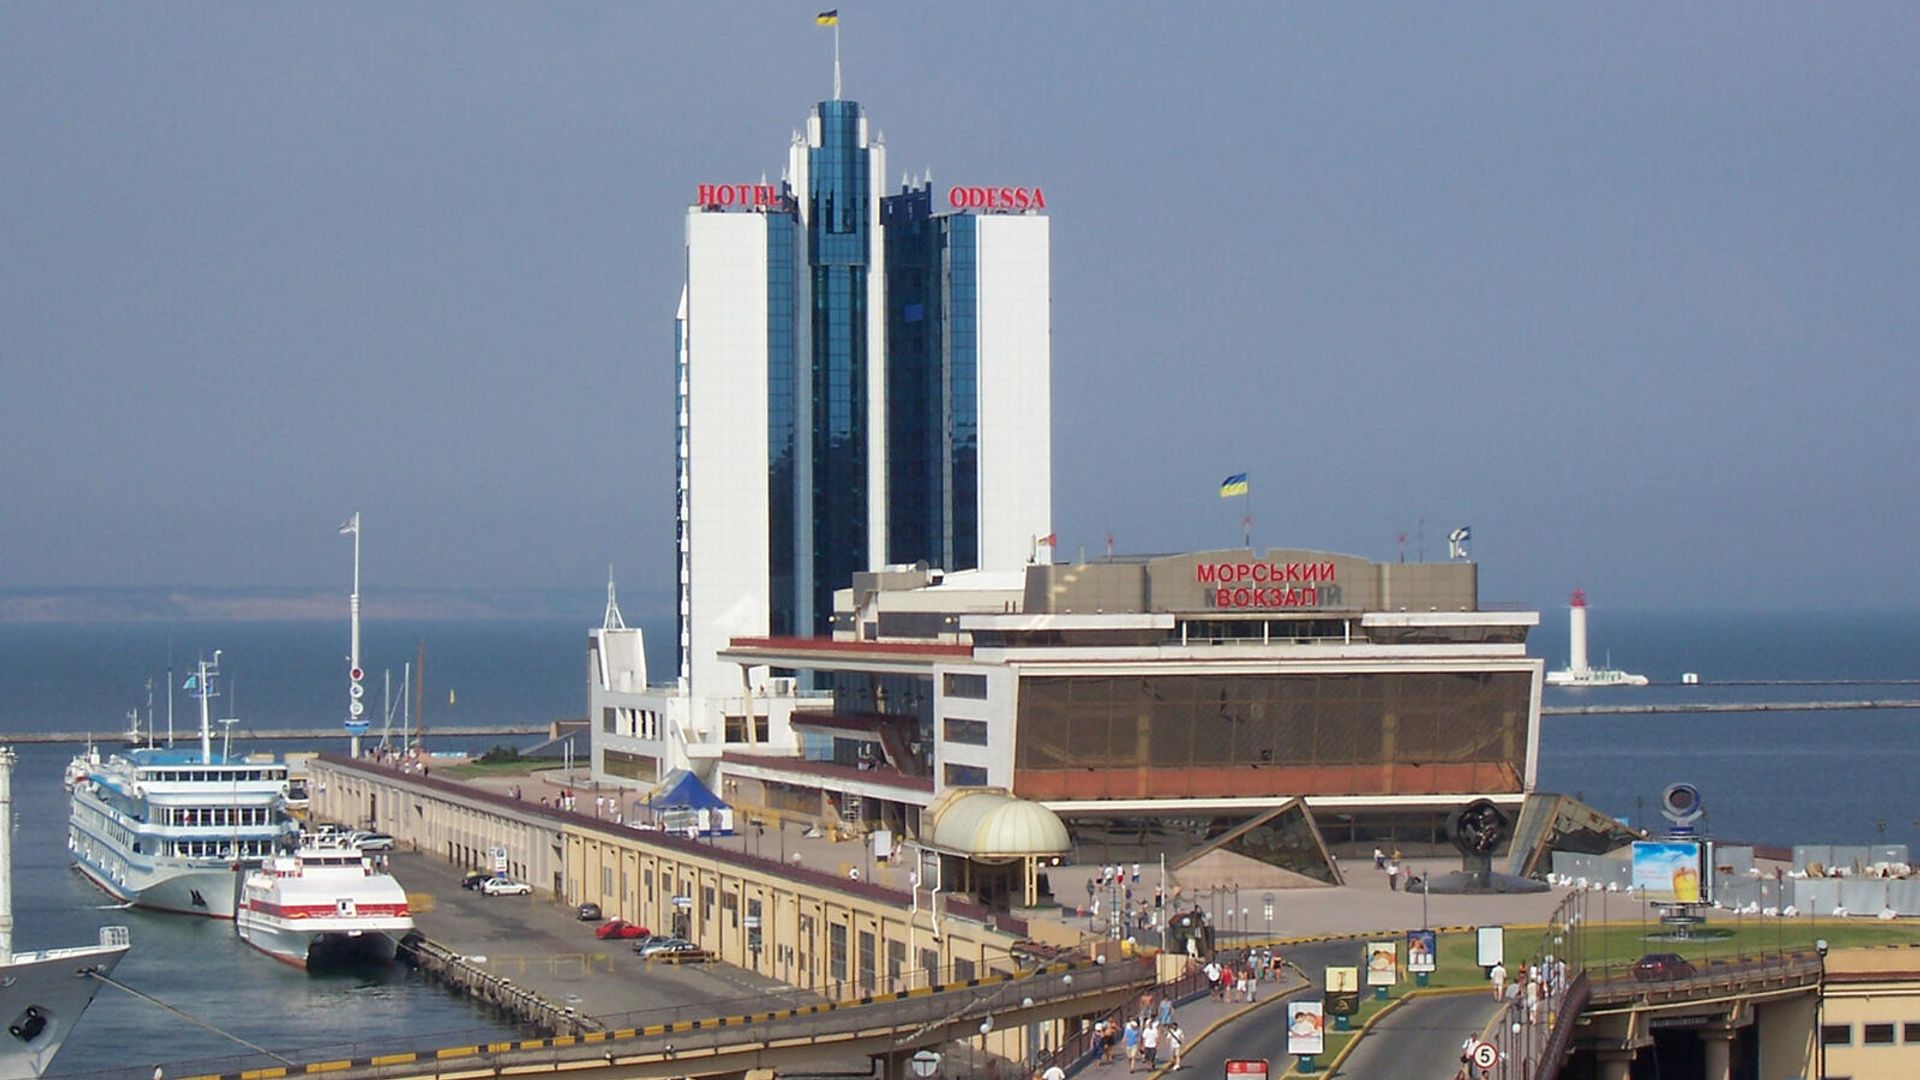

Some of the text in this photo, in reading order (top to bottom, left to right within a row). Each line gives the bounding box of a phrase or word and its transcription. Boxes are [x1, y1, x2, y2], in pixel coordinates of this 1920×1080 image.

[697, 184, 783, 206] HOTEL
[948, 186, 1046, 209] ODESSA
[1196, 561, 1336, 583] МОРСЬКИЙ
[1216, 588, 1318, 608] ВОКЗАЛ
[1480, 1048, 1491, 1064] 5
